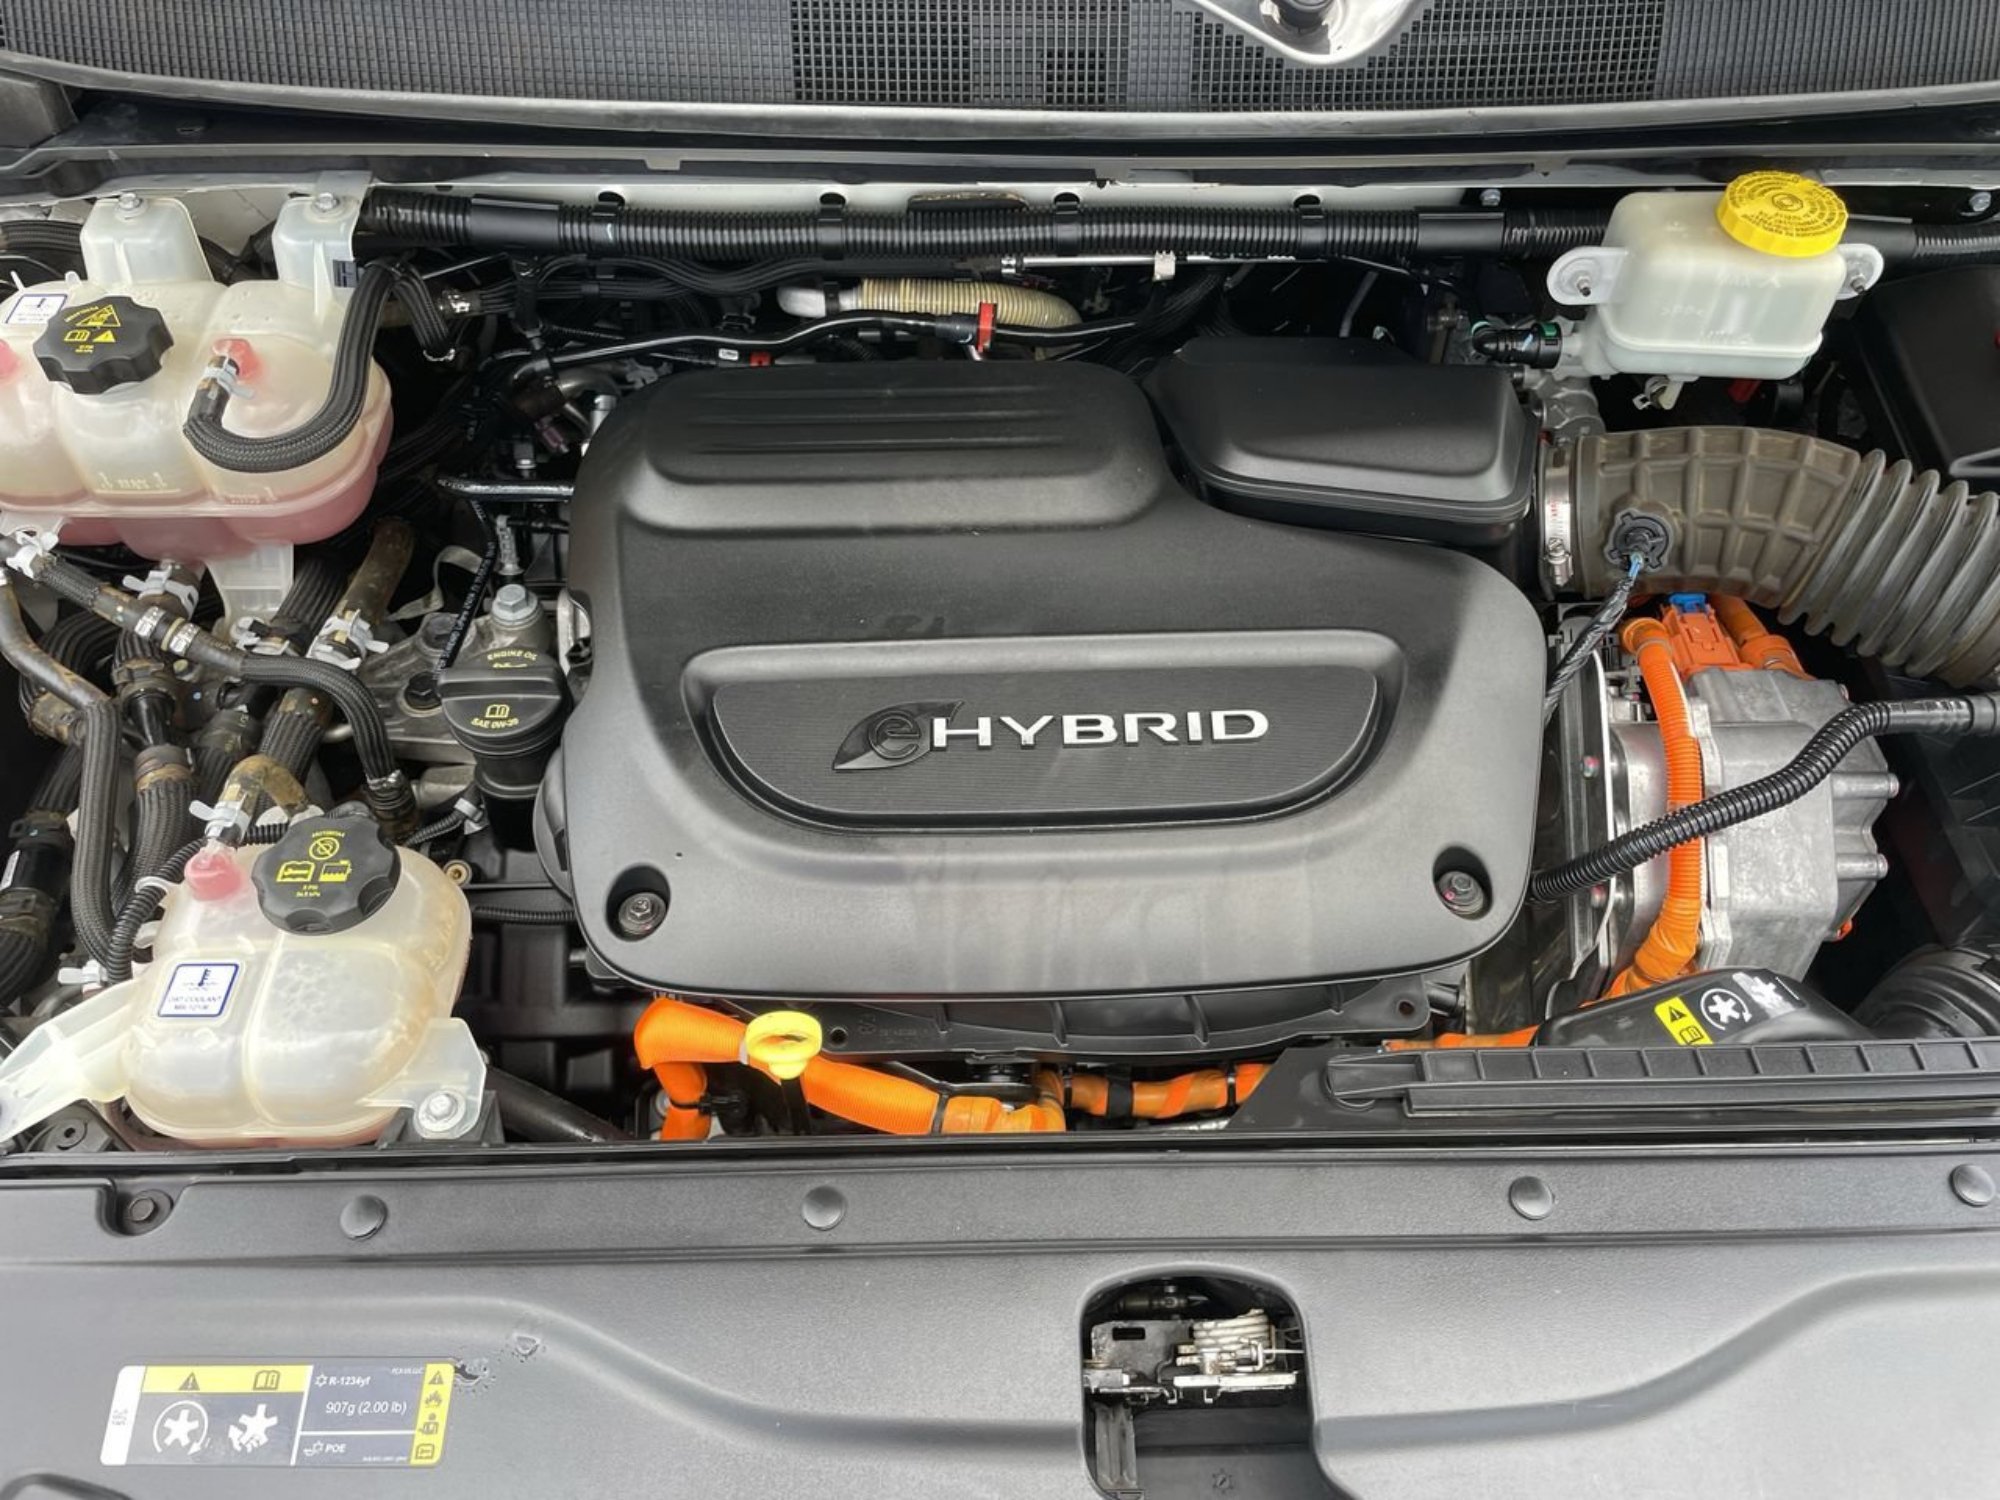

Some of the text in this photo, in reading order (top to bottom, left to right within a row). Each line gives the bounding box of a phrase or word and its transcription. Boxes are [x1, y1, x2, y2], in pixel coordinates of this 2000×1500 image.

[487, 650, 538, 661] ENGINE OIL
[471, 718, 490, 729] SAE
[931, 710, 1269, 749] HYBRID
[329, 1375, 371, 1387] R-1234yf
[325, 1401, 407, 1416] 907g (2.00 lb)
[325, 1444, 347, 1453] POE
